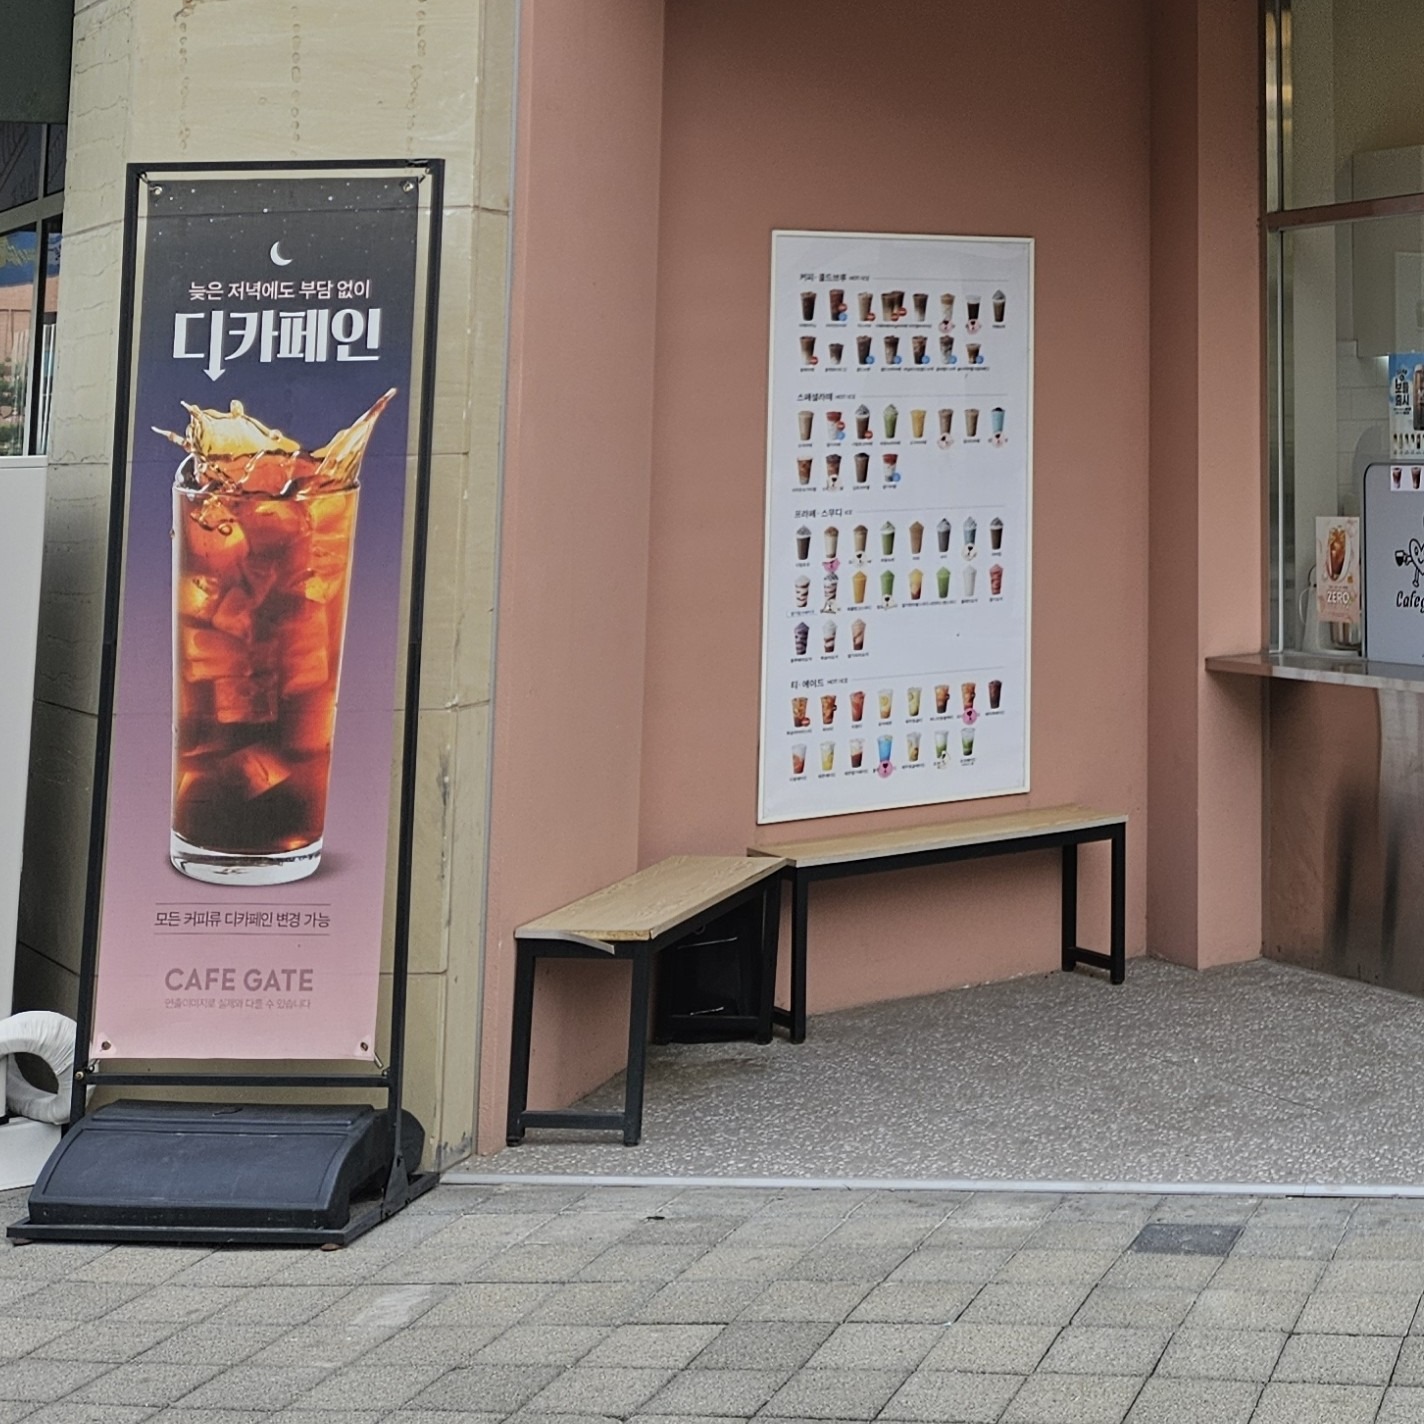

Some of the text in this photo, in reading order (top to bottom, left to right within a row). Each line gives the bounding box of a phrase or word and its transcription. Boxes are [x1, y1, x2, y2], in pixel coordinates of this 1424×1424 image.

[188, 280, 371, 300] 늦은 저녁에도 부담 없이
[172, 308, 382, 382] 디카페인
[1327, 591, 1350, 604] ZERO
[154, 911, 331, 928] 모든 커피류 디카페인 변경 가능
[164, 967, 314, 992] CAFE GATE
[265, 998, 275, 1009] 수
[276, 998, 311, 1010] 있습니다
